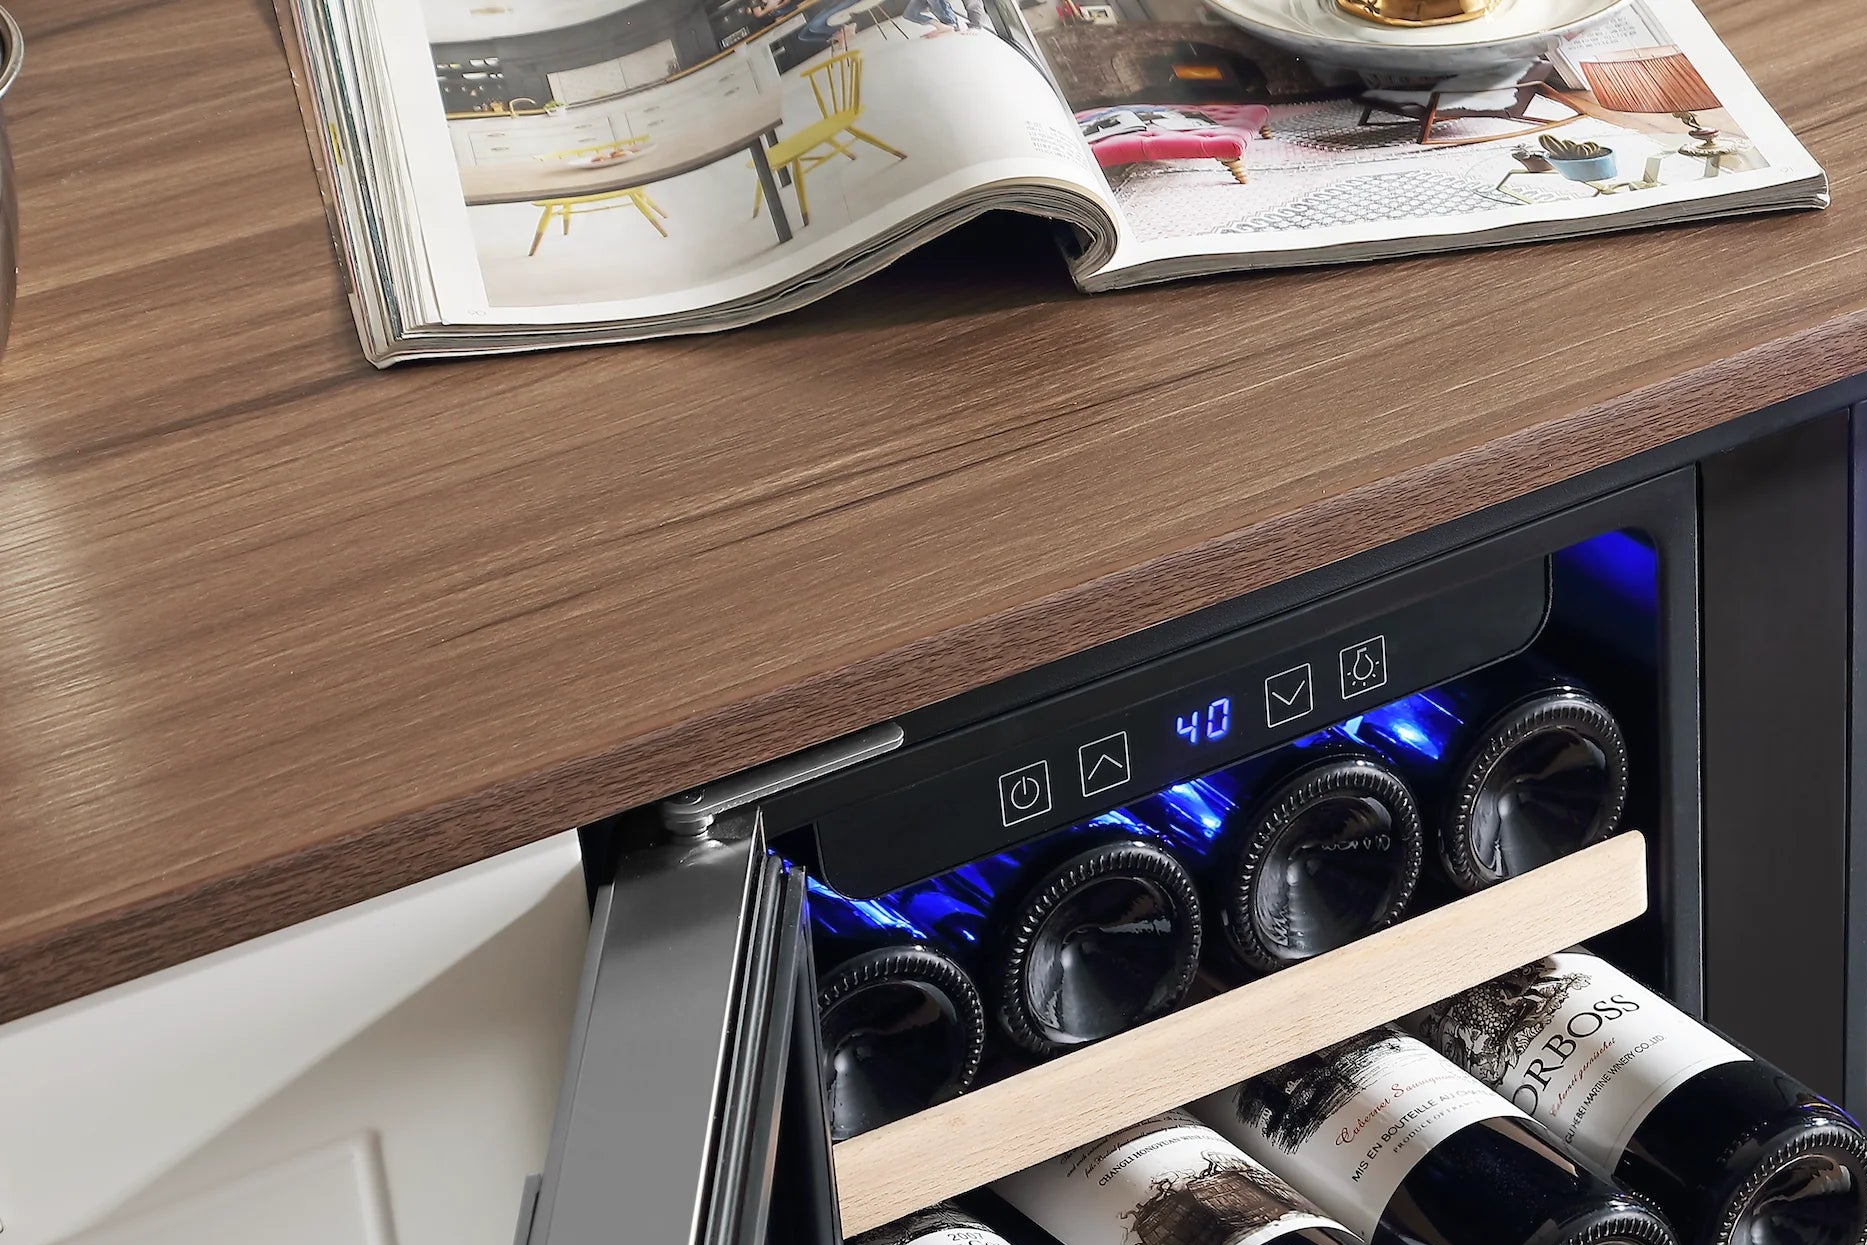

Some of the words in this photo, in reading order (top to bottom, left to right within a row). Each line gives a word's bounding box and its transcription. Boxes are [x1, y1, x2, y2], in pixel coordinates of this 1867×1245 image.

[1175, 697, 1232, 746] 40
[1607, 1048, 1637, 1080] WINERY
[1335, 1097, 1392, 1147] Cabernet
[1393, 1118, 1433, 1154] PRODUCE
[1351, 1160, 1369, 1183] MIS
[1366, 1142, 1384, 1160] EN
[1380, 1098, 1439, 1143] BOUTEILLE
[1098, 1154, 1134, 1186] CHANGLI
[947, 1231, 985, 1242] 2007
